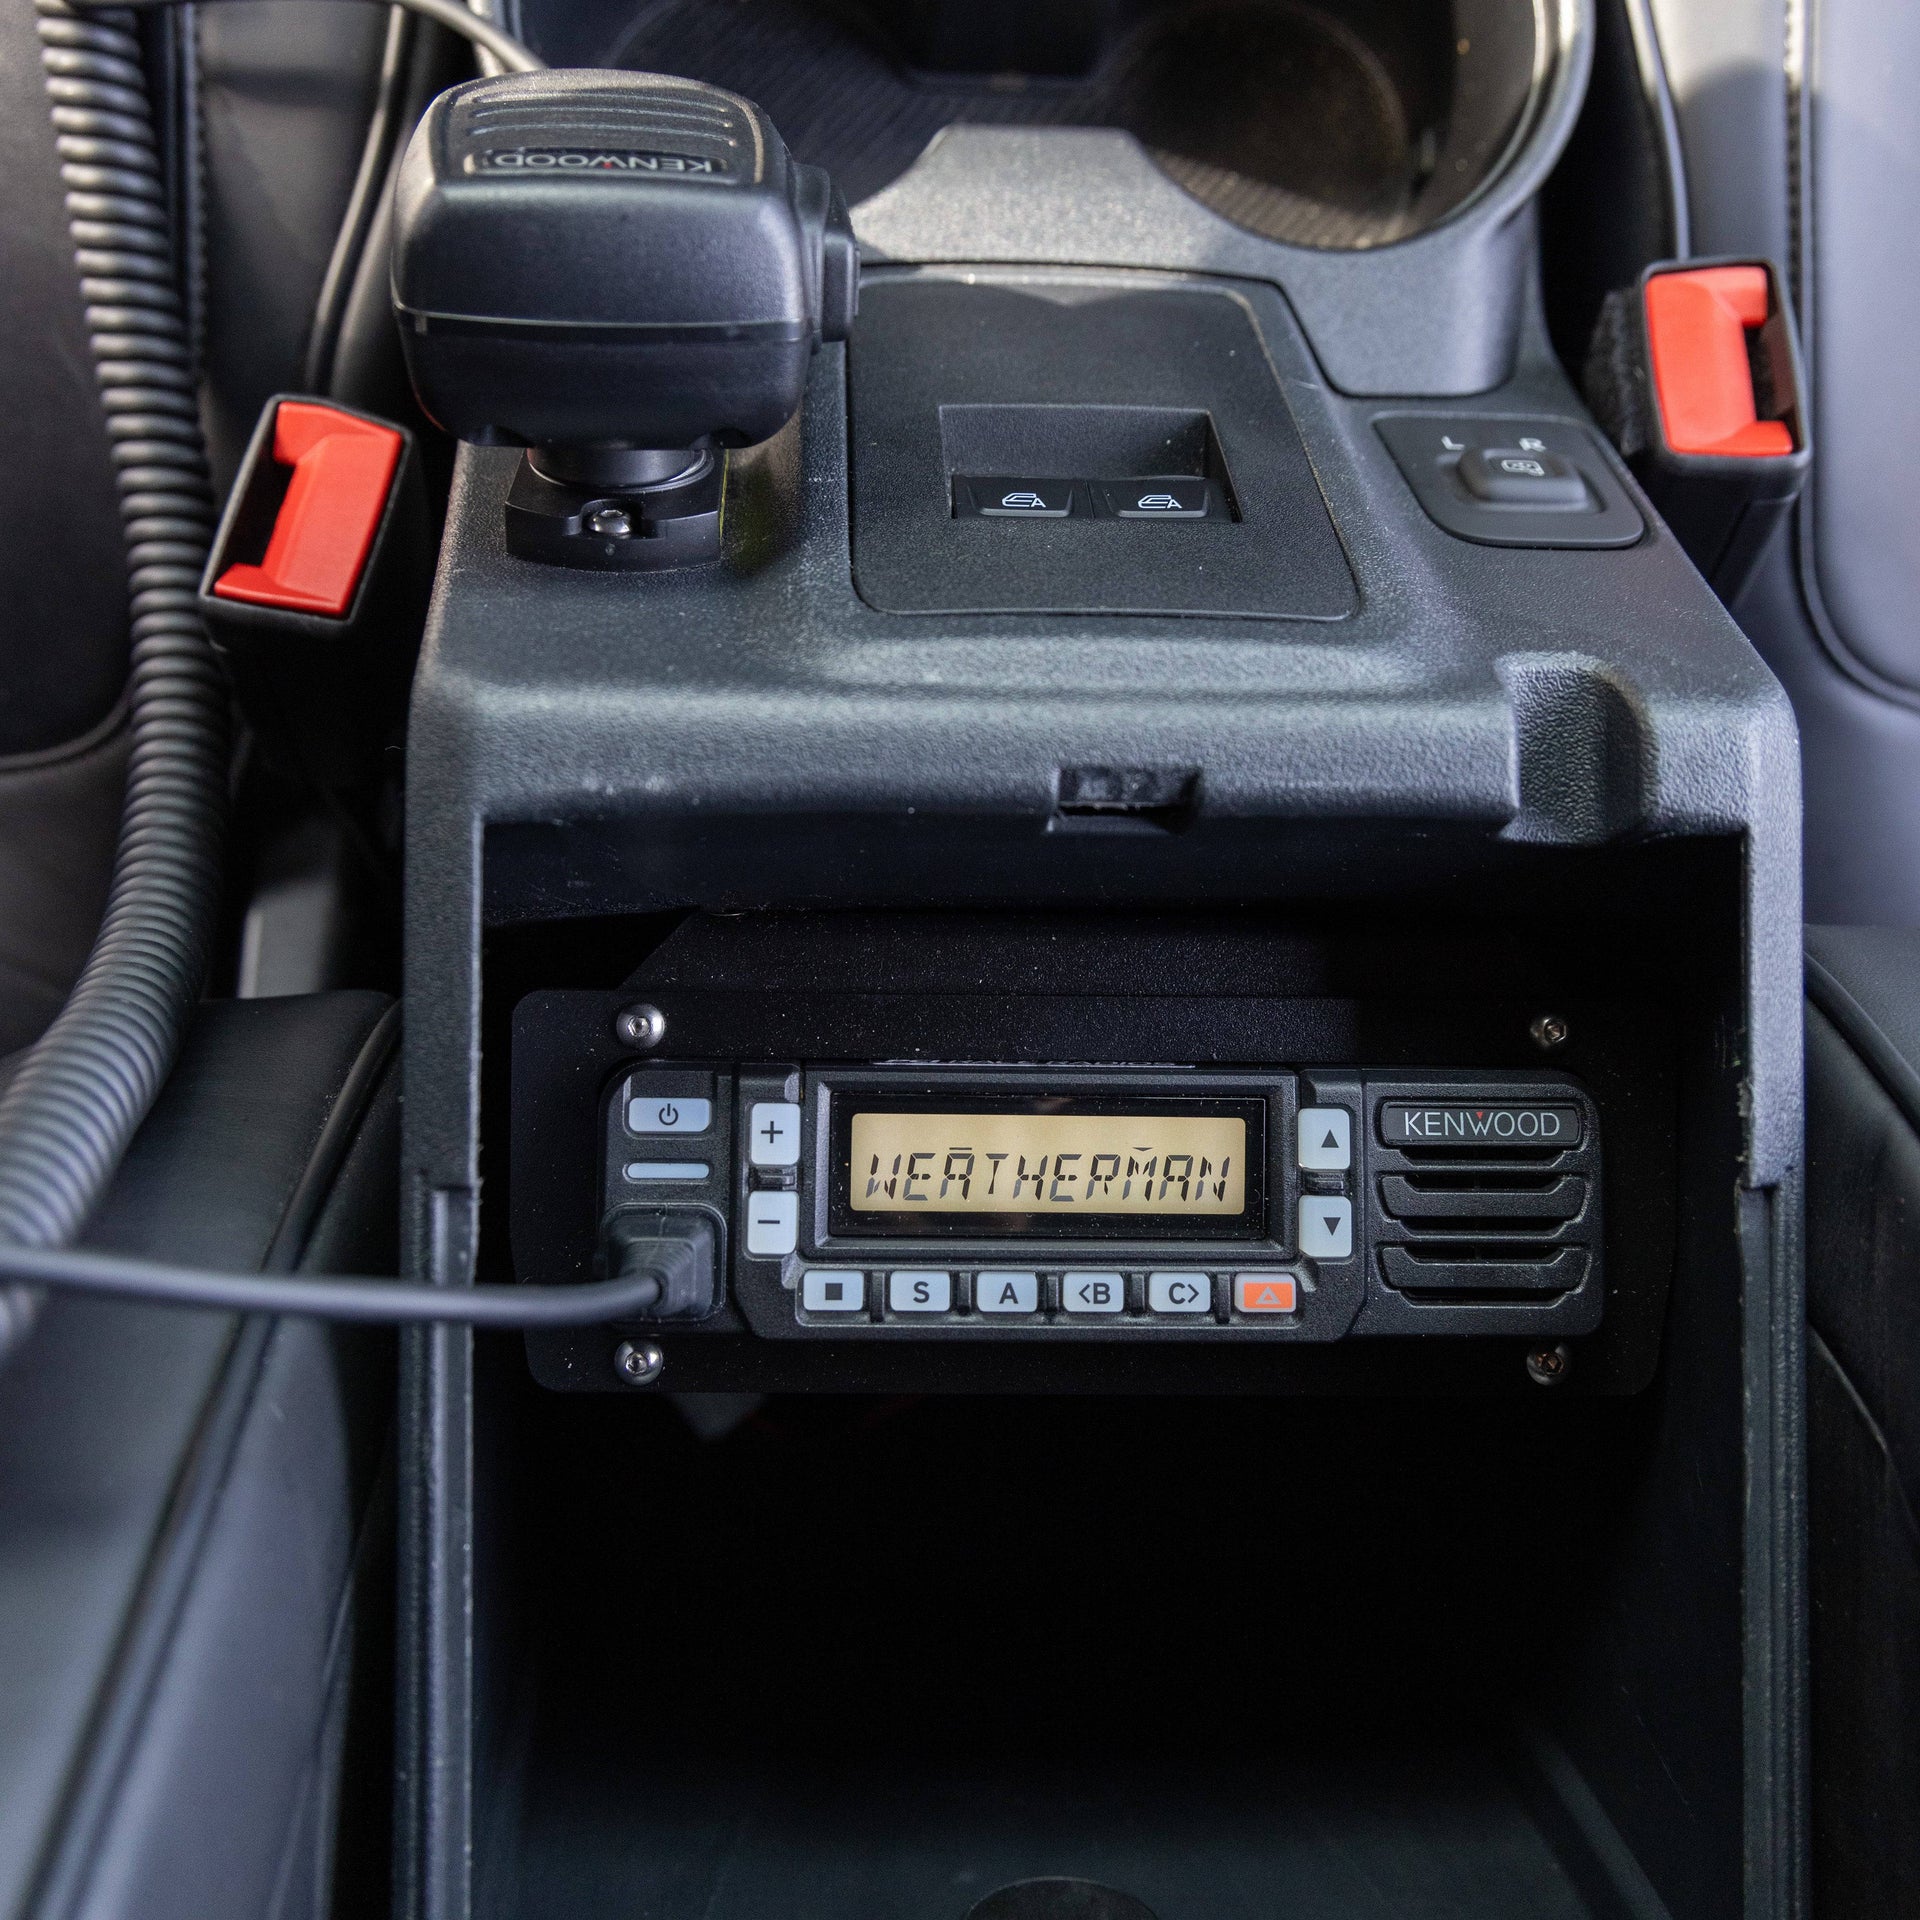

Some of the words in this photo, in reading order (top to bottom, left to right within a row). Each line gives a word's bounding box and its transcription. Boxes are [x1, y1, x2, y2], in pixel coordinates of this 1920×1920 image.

[494, 154, 712, 173] KENWOOD
[1440, 435, 1465, 451] L
[1519, 437, 1546, 452] R
[1403, 1110, 1561, 1138] KENWOOD
[866, 1149, 1230, 1202] WEATHERMAN
[912, 1280, 931, 1304] S
[998, 1282, 1020, 1305] A
